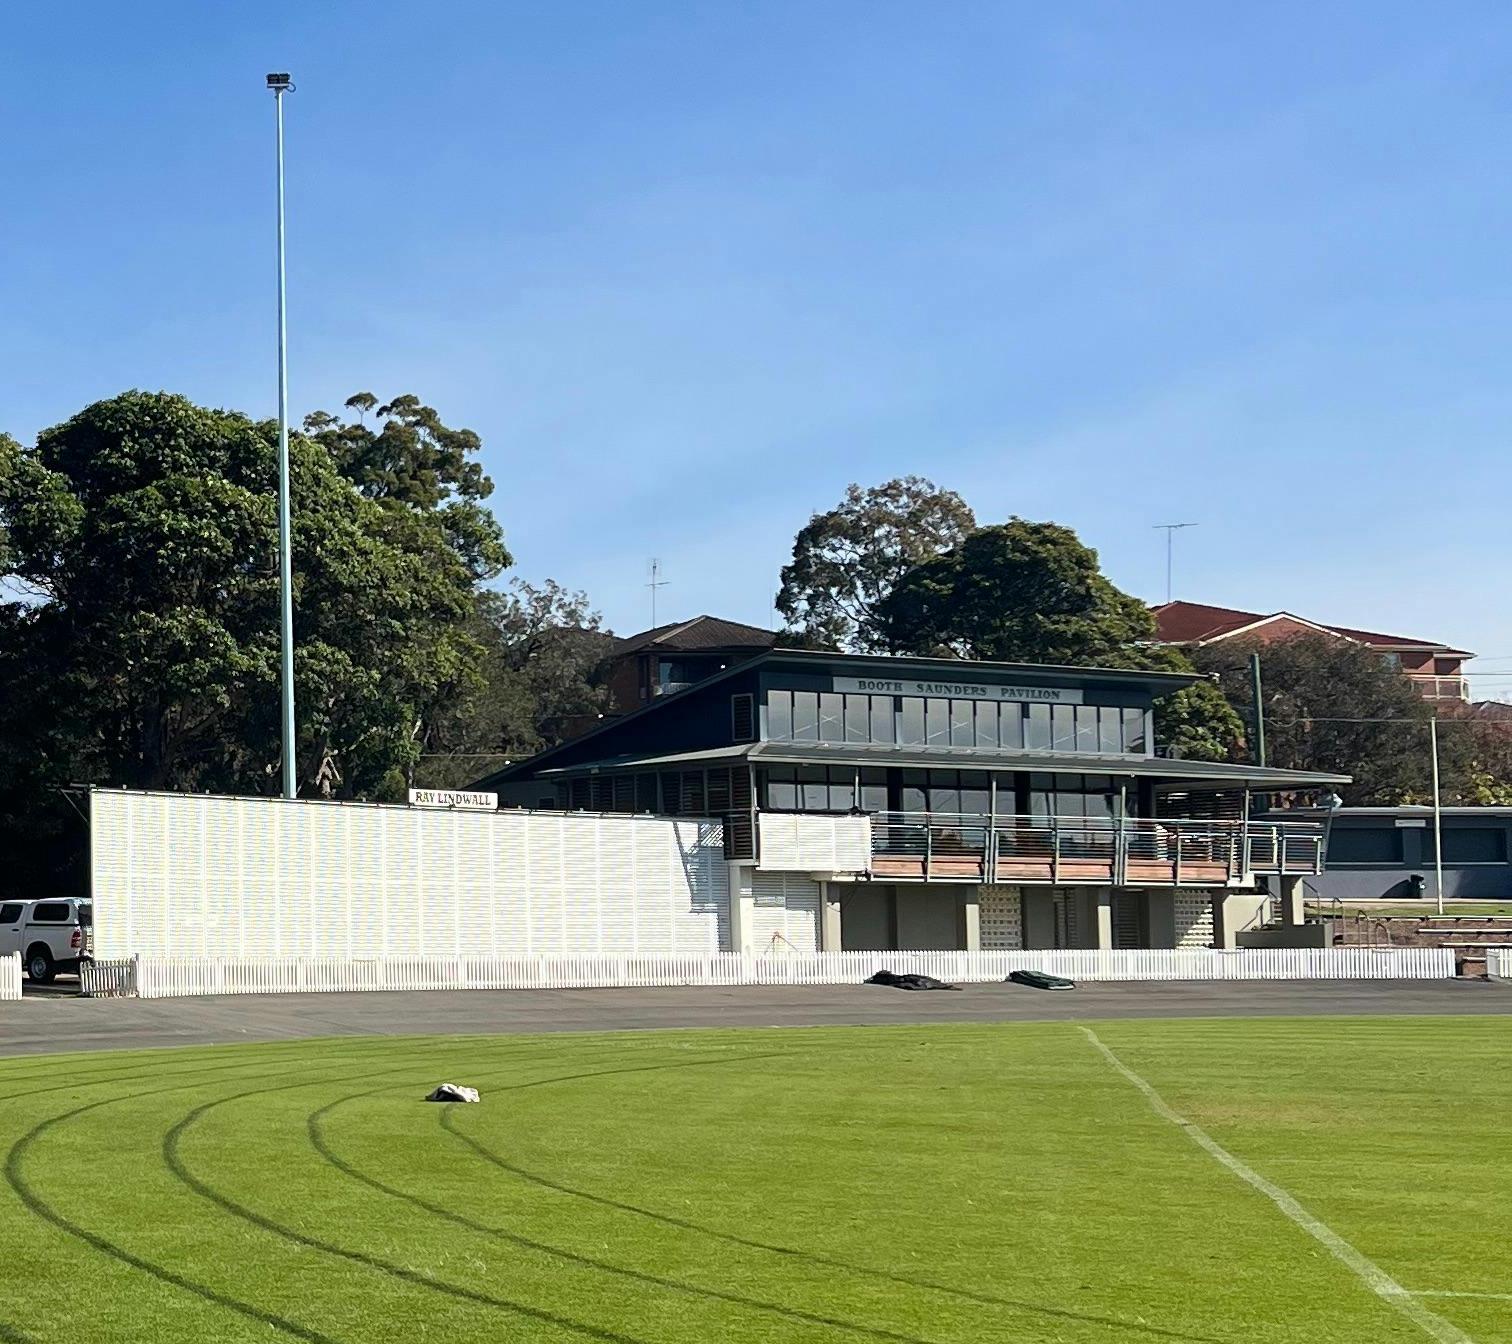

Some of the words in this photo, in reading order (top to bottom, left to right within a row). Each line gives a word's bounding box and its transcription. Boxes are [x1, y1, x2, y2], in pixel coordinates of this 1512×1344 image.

[857, 680, 903, 692] BOOTH
[916, 683, 987, 697] SAUNDERS
[1000, 687, 1061, 700] PAVILION
[415, 791, 435, 803] RAY
[438, 792, 491, 806] LINDWALL
